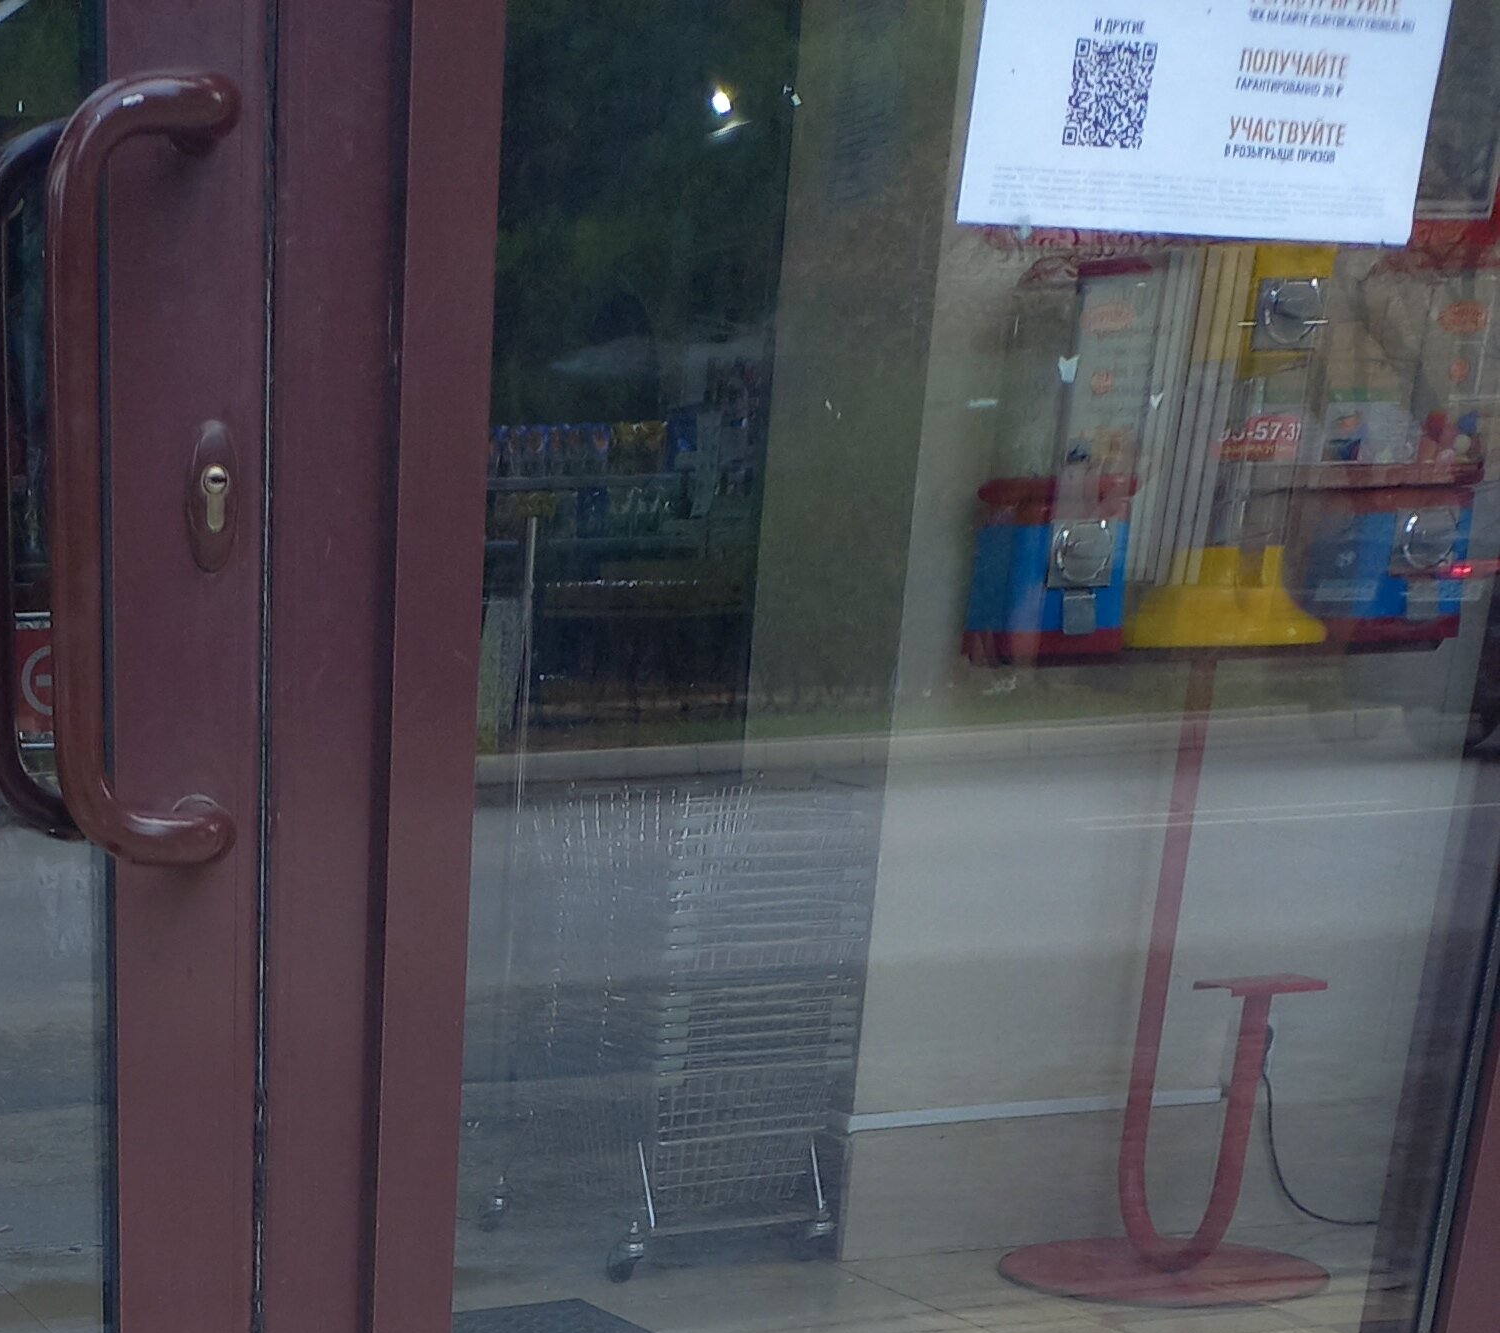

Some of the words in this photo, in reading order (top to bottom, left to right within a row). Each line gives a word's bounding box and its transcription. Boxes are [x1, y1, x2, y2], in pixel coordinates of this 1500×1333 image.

[1094, 17, 1102, 32] И
[1104, 18, 1146, 35] ДРУГИЕ
[1238, 47, 1350, 80] ПОЛУЧАЙТЕ
[1229, 115, 1349, 148] УЧАСТВУЙТЕ
[1224, 144, 1231, 158] В
[1233, 144, 1295, 164] РОЗЫГРЫШЕ
[1296, 148, 1337, 165] ПРИЗОВ
